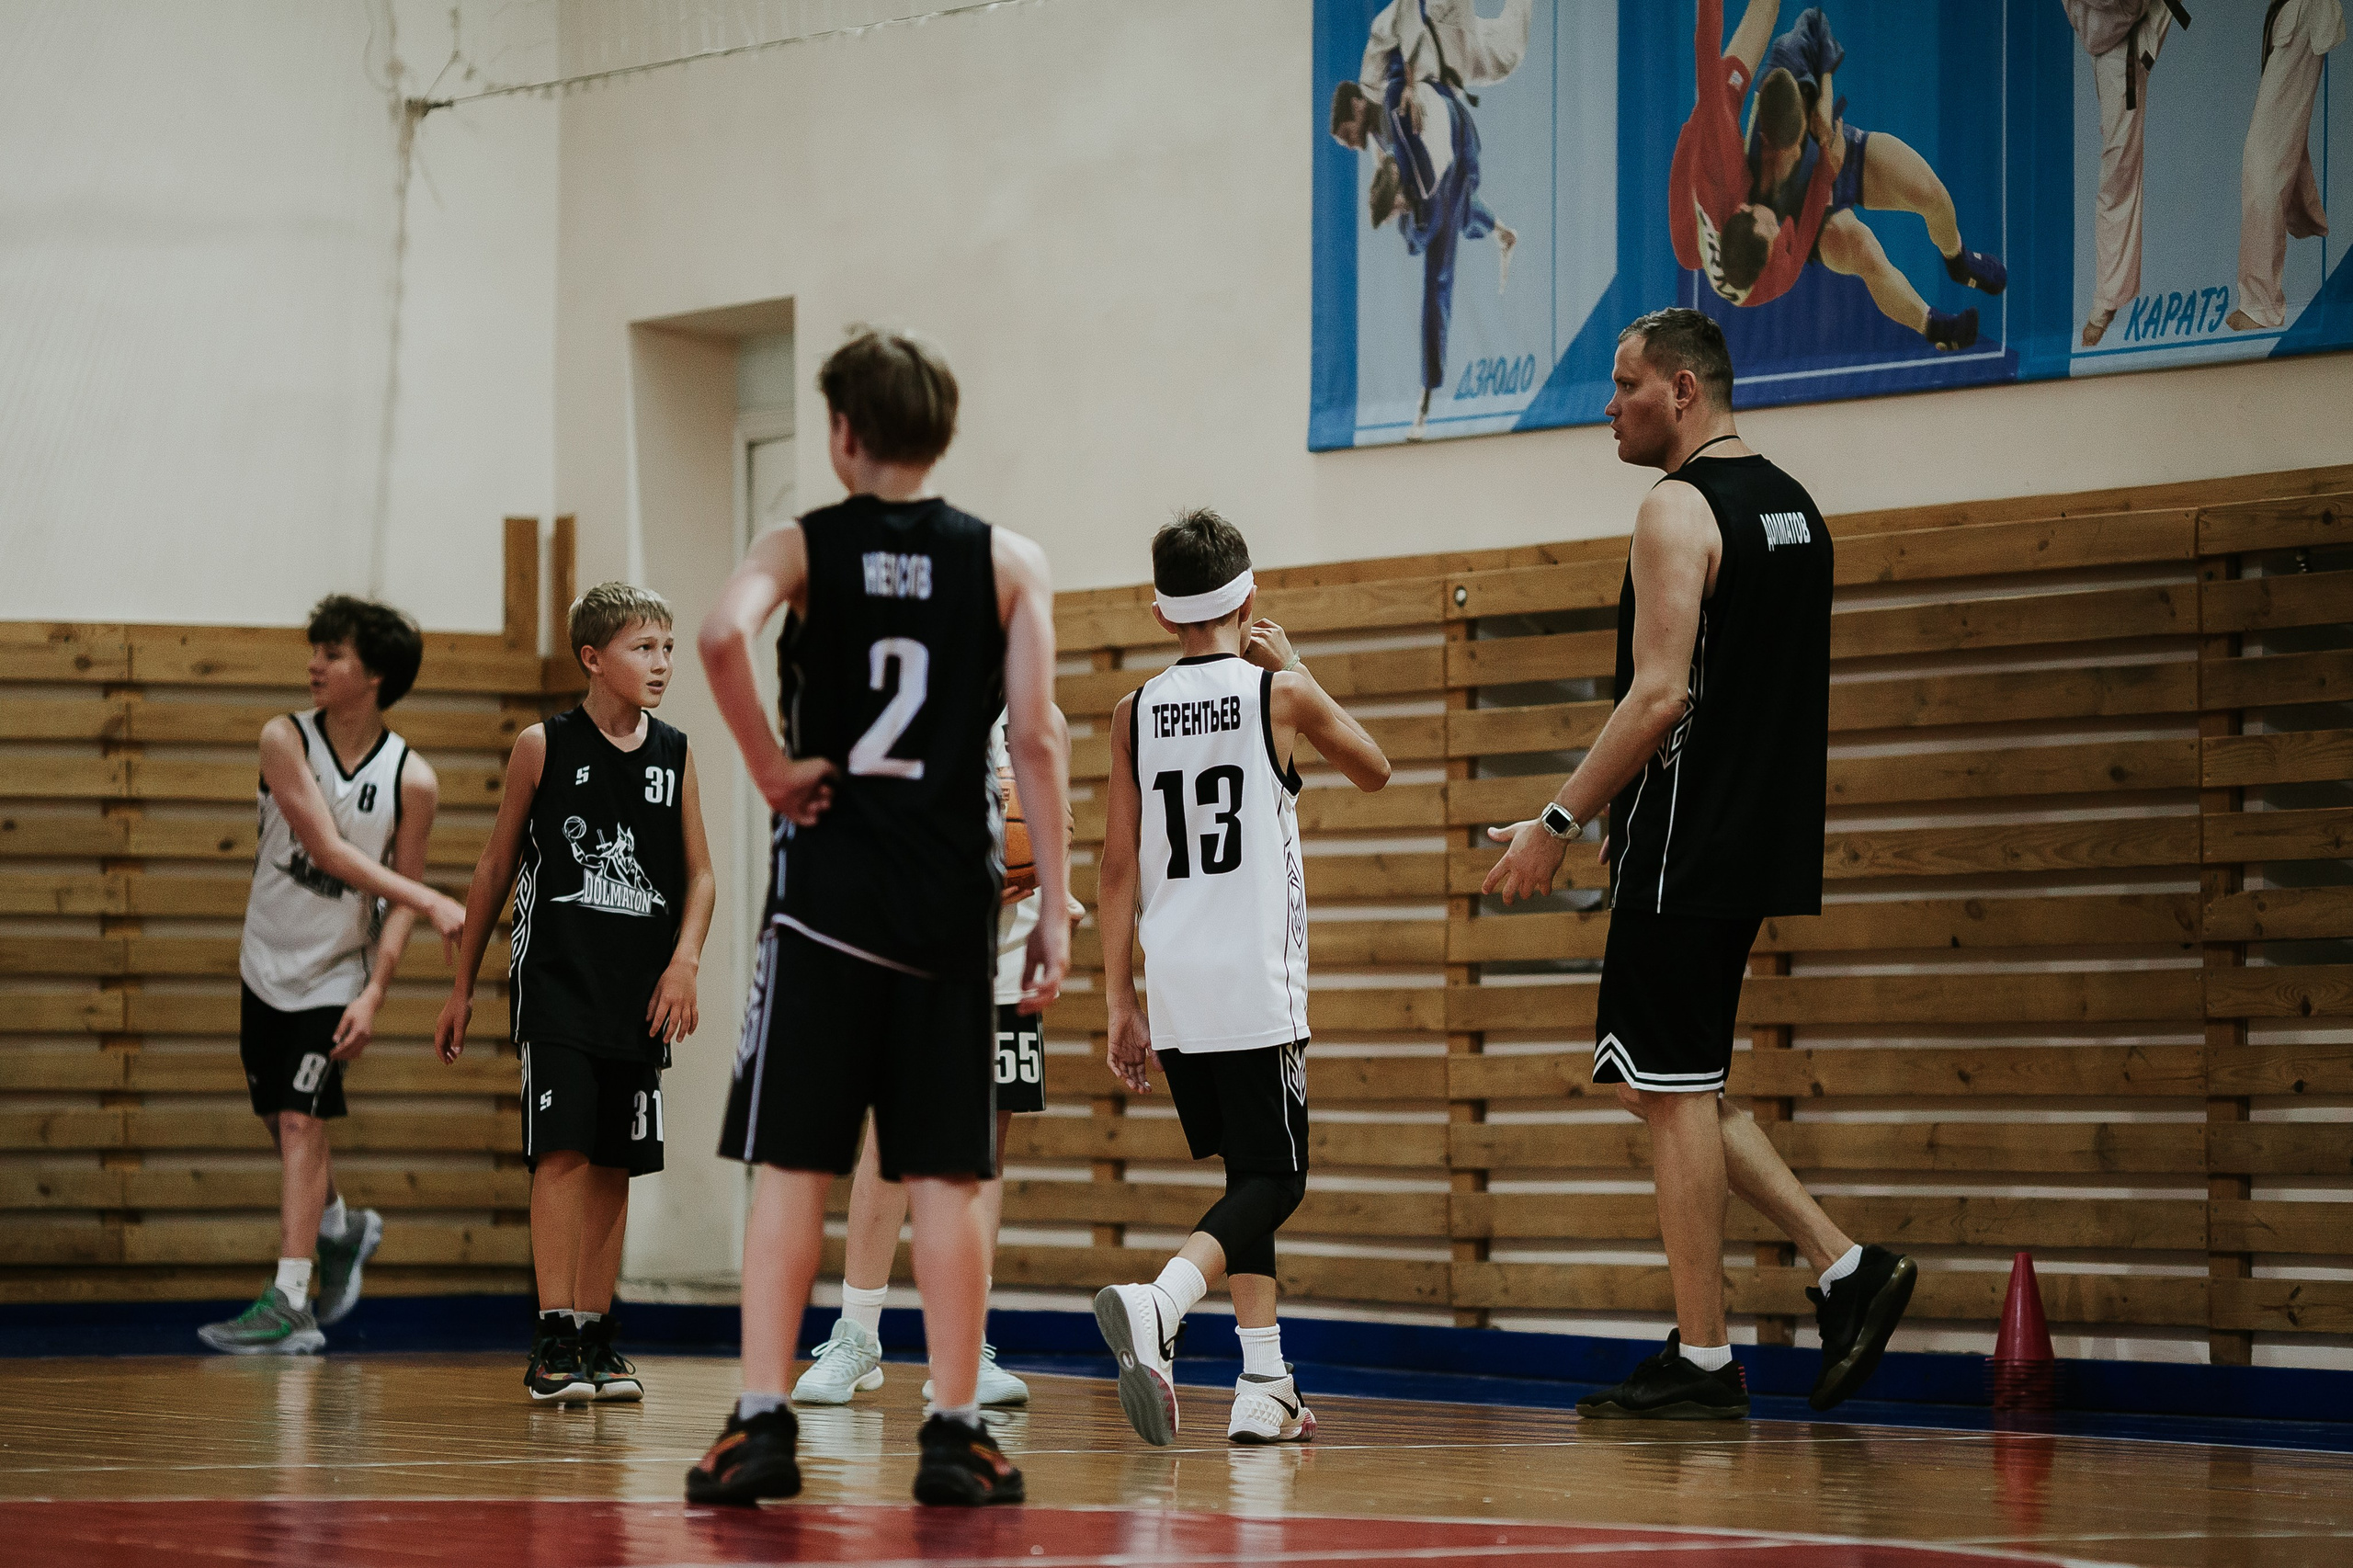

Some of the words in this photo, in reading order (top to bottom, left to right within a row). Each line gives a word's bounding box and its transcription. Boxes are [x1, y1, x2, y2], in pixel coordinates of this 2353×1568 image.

[2123, 286, 2229, 341] КАРАТЭ
[1453, 354, 1535, 400] ДЗЮДО
[1759, 511, 1811, 551] ДОЛМАТОВ
[848, 637, 929, 780] 2
[1152, 696, 1242, 739] ТЕРЕНТЬЕВ
[358, 783, 378, 813] 8
[644, 766, 676, 807] 31
[1153, 764, 1245, 880] 13
[293, 1052, 327, 1093] 8
[994, 1031, 1040, 1084] 55
[631, 1089, 665, 1142] 31
